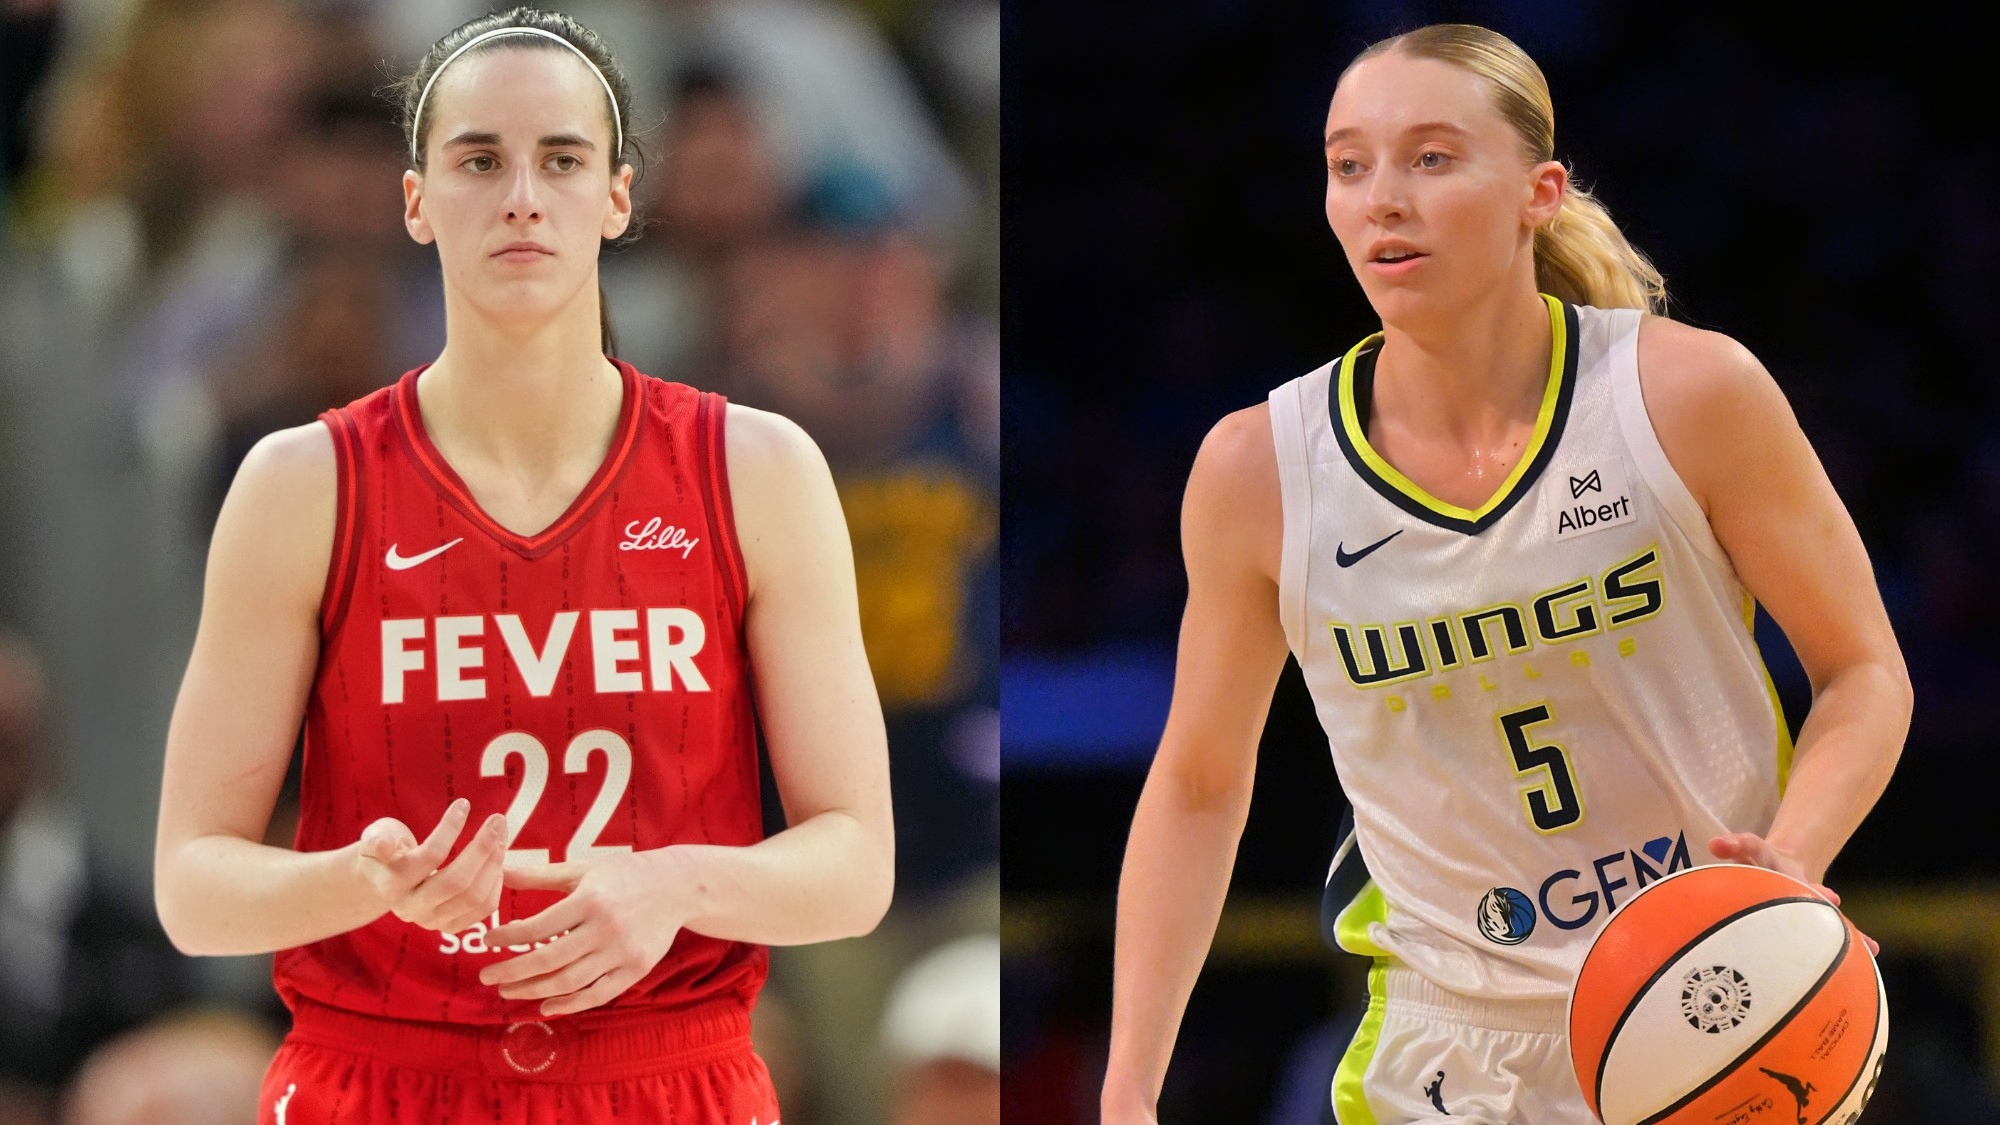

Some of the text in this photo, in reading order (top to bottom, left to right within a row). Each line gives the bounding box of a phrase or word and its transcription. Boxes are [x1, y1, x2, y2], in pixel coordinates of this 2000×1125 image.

[619, 516, 700, 560] Lilly
[1557, 495, 1630, 535] Albert
[379, 606, 712, 706] FEVER
[1329, 543, 1665, 691] WINGS
[1385, 636, 1638, 712] DALLAS
[479, 728, 634, 866] 22
[1495, 700, 1586, 836] 5
